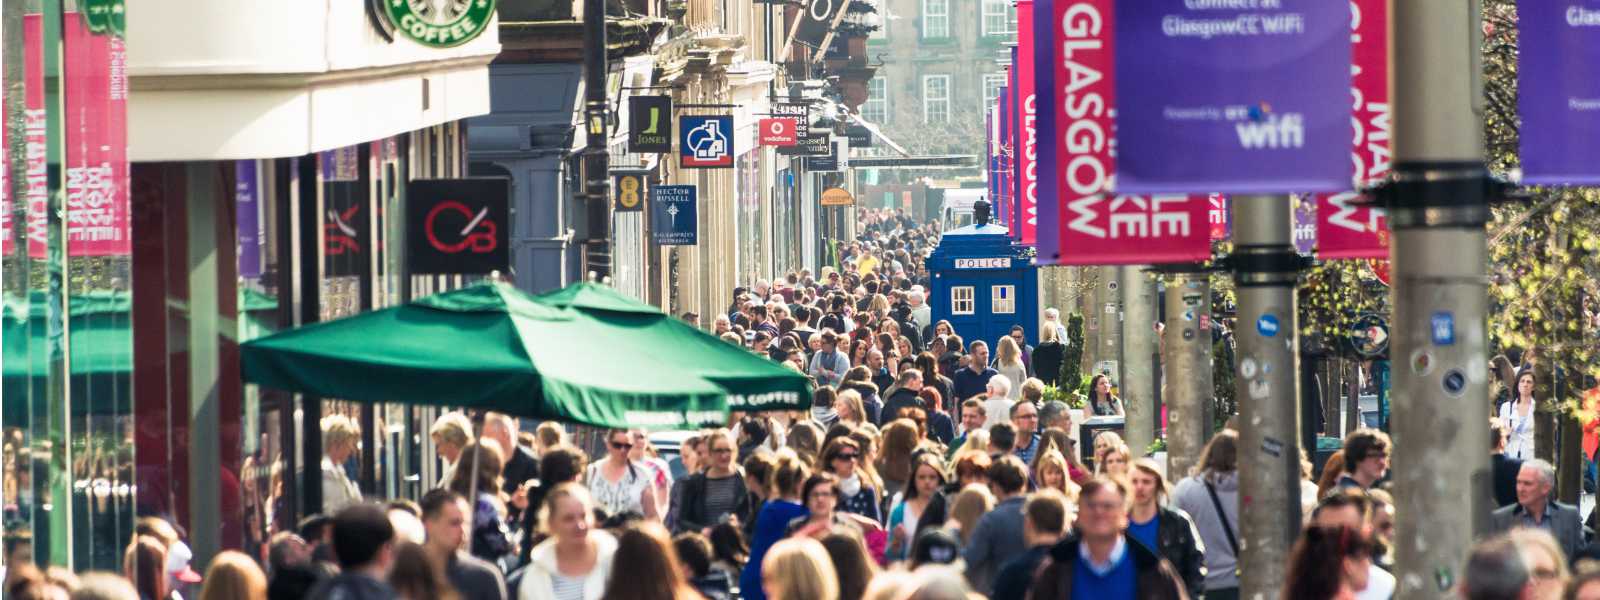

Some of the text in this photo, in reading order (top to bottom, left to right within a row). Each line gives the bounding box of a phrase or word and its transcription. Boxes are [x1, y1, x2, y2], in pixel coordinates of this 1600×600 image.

[401, 14, 476, 43] COFFEE
[1161, 15, 1259, 39] GlasgowCC
[1062, 3, 1106, 238] GLASGOW
[1235, 113, 1305, 148] wifi
[636, 134, 666, 145] JONES
[958, 259, 1008, 268] POLICE
